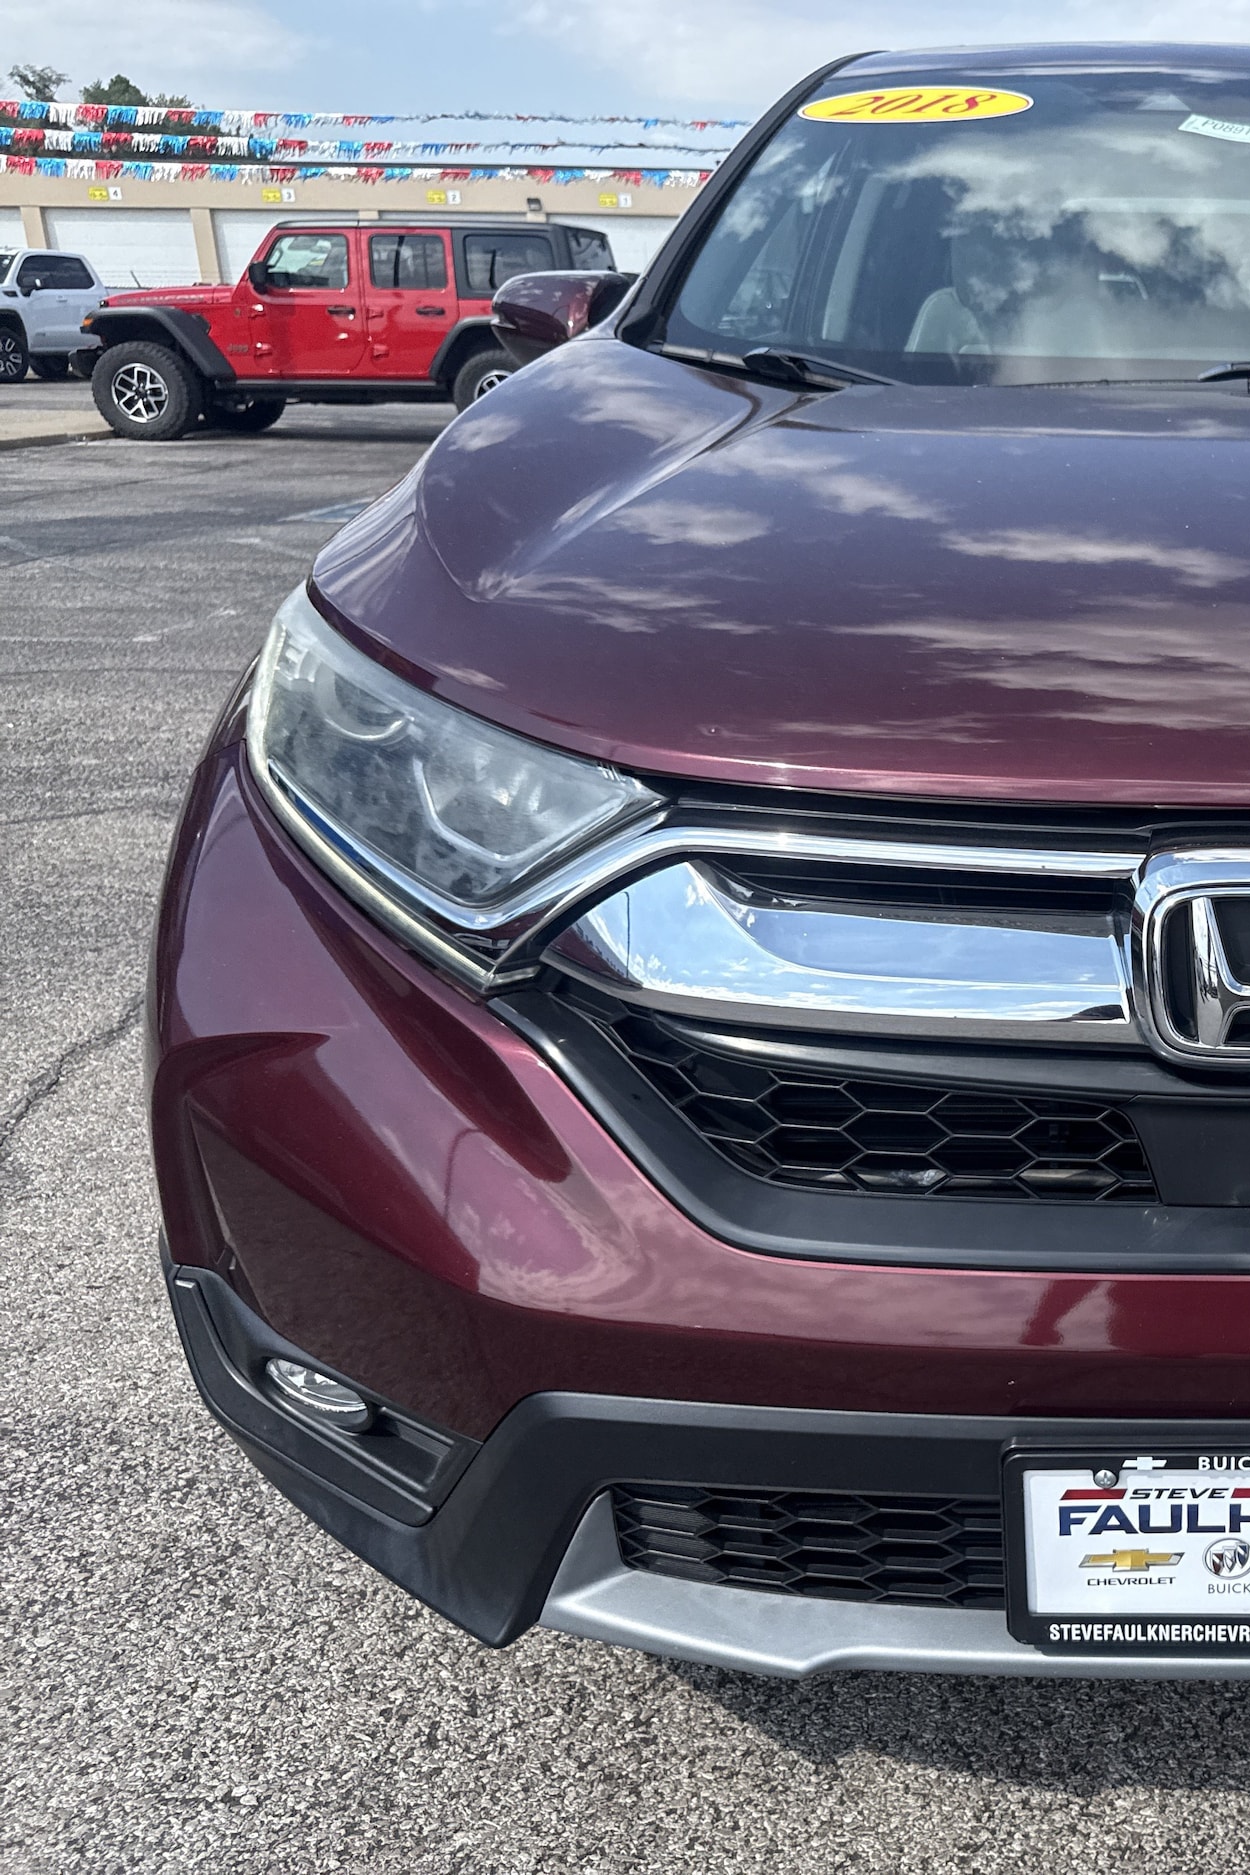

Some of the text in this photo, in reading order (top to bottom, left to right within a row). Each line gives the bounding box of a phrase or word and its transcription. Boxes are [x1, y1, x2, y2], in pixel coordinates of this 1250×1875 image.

[829, 93, 998, 117] 2018
[1130, 1487, 1230, 1500] STEVE
[1086, 1576, 1177, 1587] CHEVROLET
